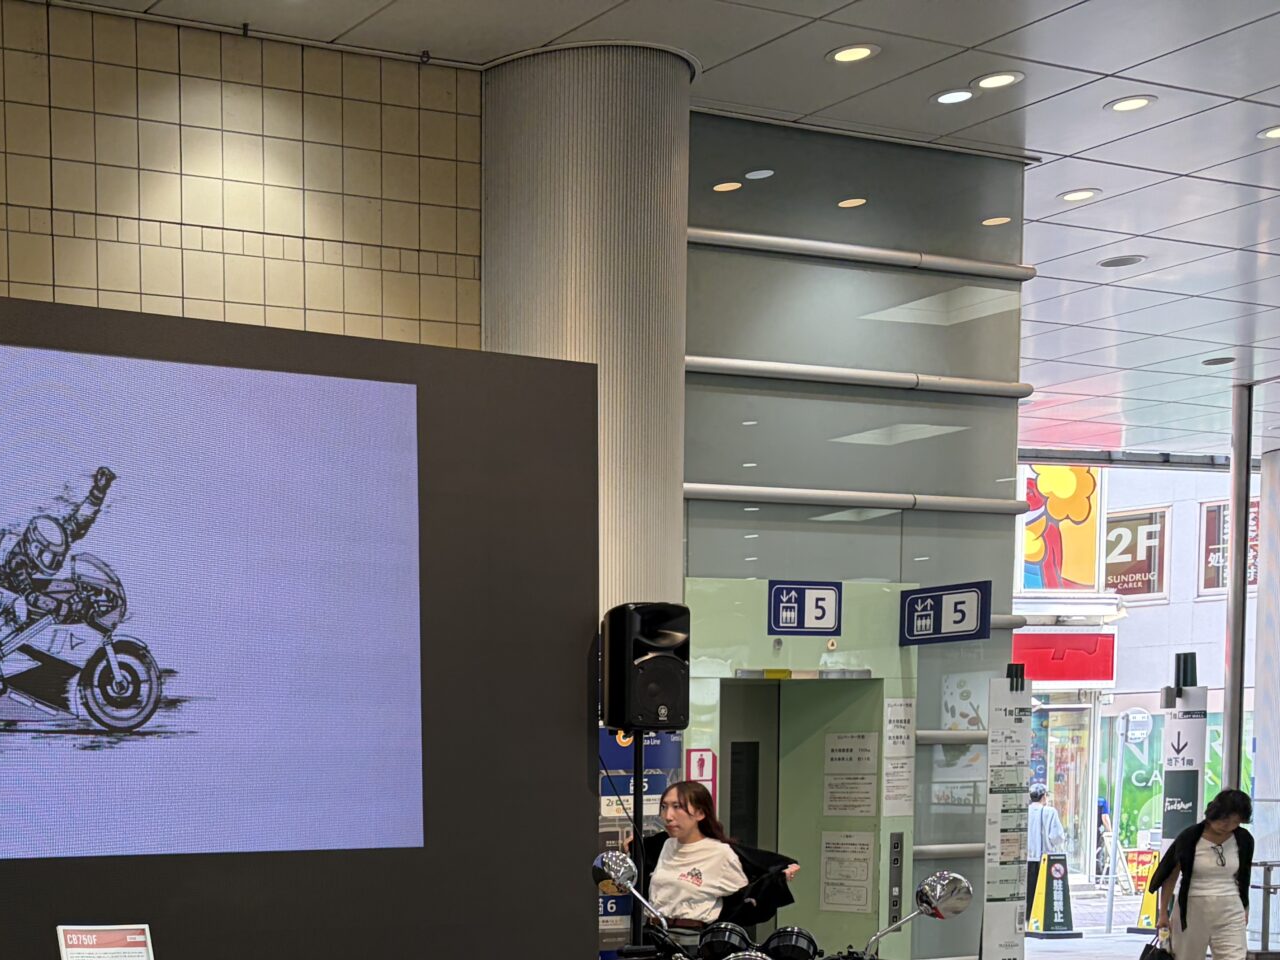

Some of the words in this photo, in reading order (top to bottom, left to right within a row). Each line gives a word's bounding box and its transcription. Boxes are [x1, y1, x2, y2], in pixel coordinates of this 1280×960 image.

[1105, 524, 1161, 564] 2F
[1107, 572, 1157, 584] SUNDRUG
[814, 597, 827, 621] 5
[952, 600, 967, 625] 5
[606, 899, 617, 914] 6
[66, 934, 98, 945] CB750F
